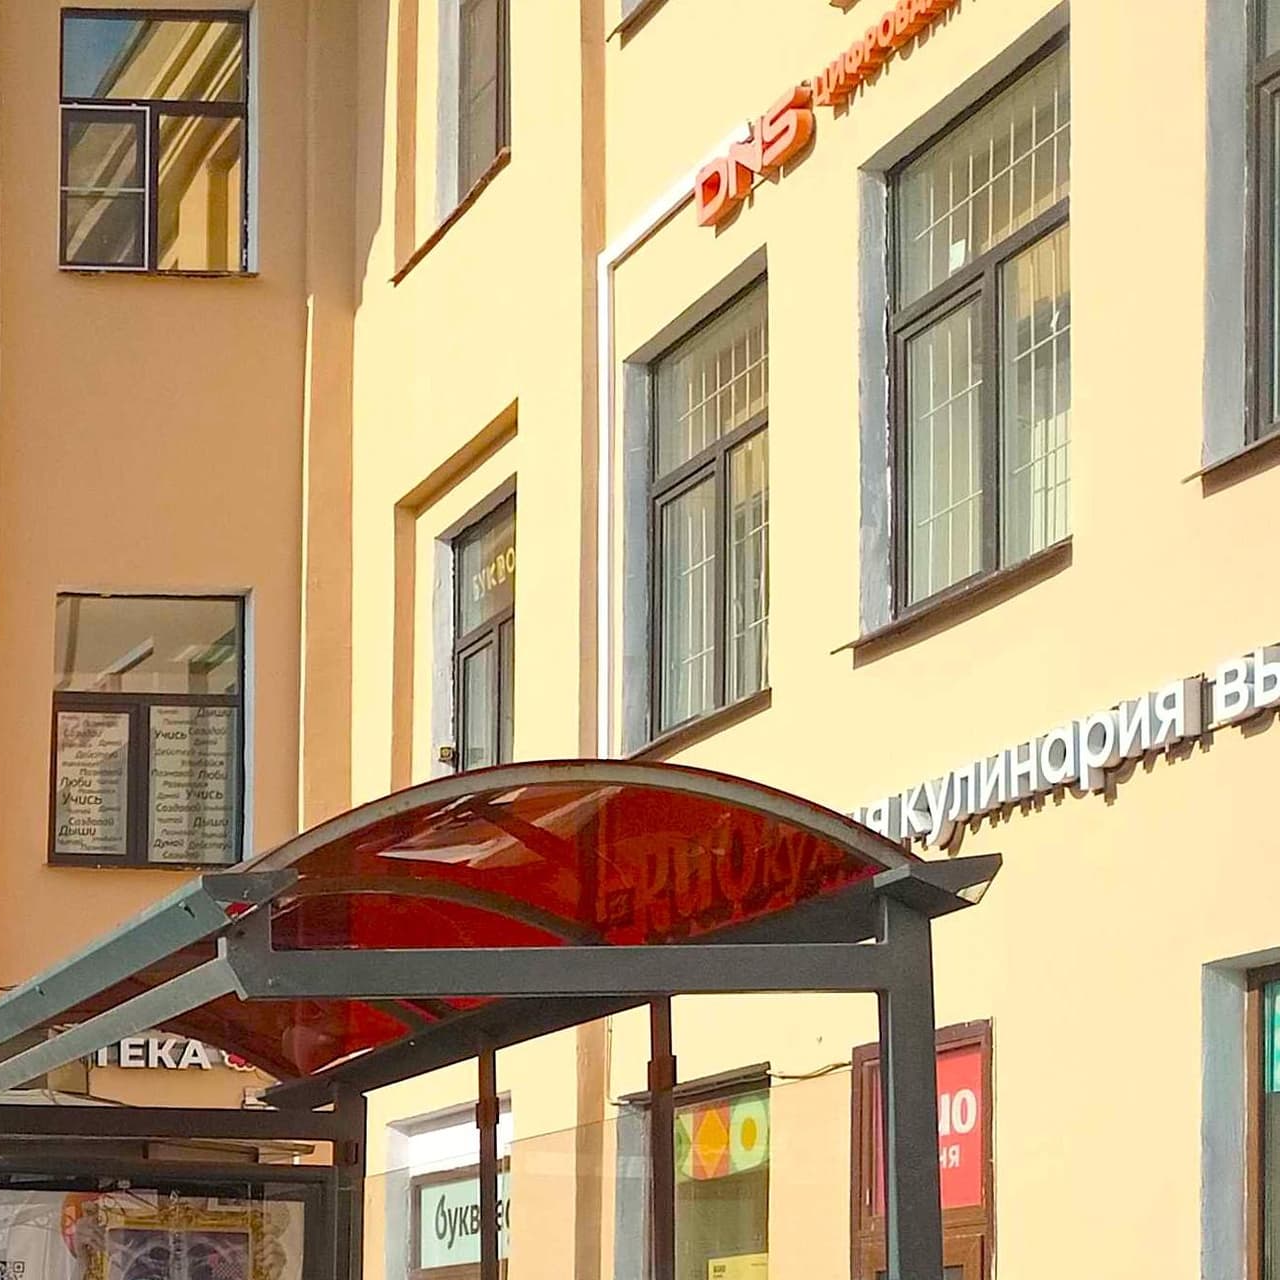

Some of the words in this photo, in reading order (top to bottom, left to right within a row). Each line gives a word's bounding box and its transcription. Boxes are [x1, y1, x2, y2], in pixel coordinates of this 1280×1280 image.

[811, 0, 936, 106] ЦИФРОВА
[695, 86, 813, 226] DNS
[62, 791, 103, 806] Учись
[900, 678, 1186, 846] кулинария
